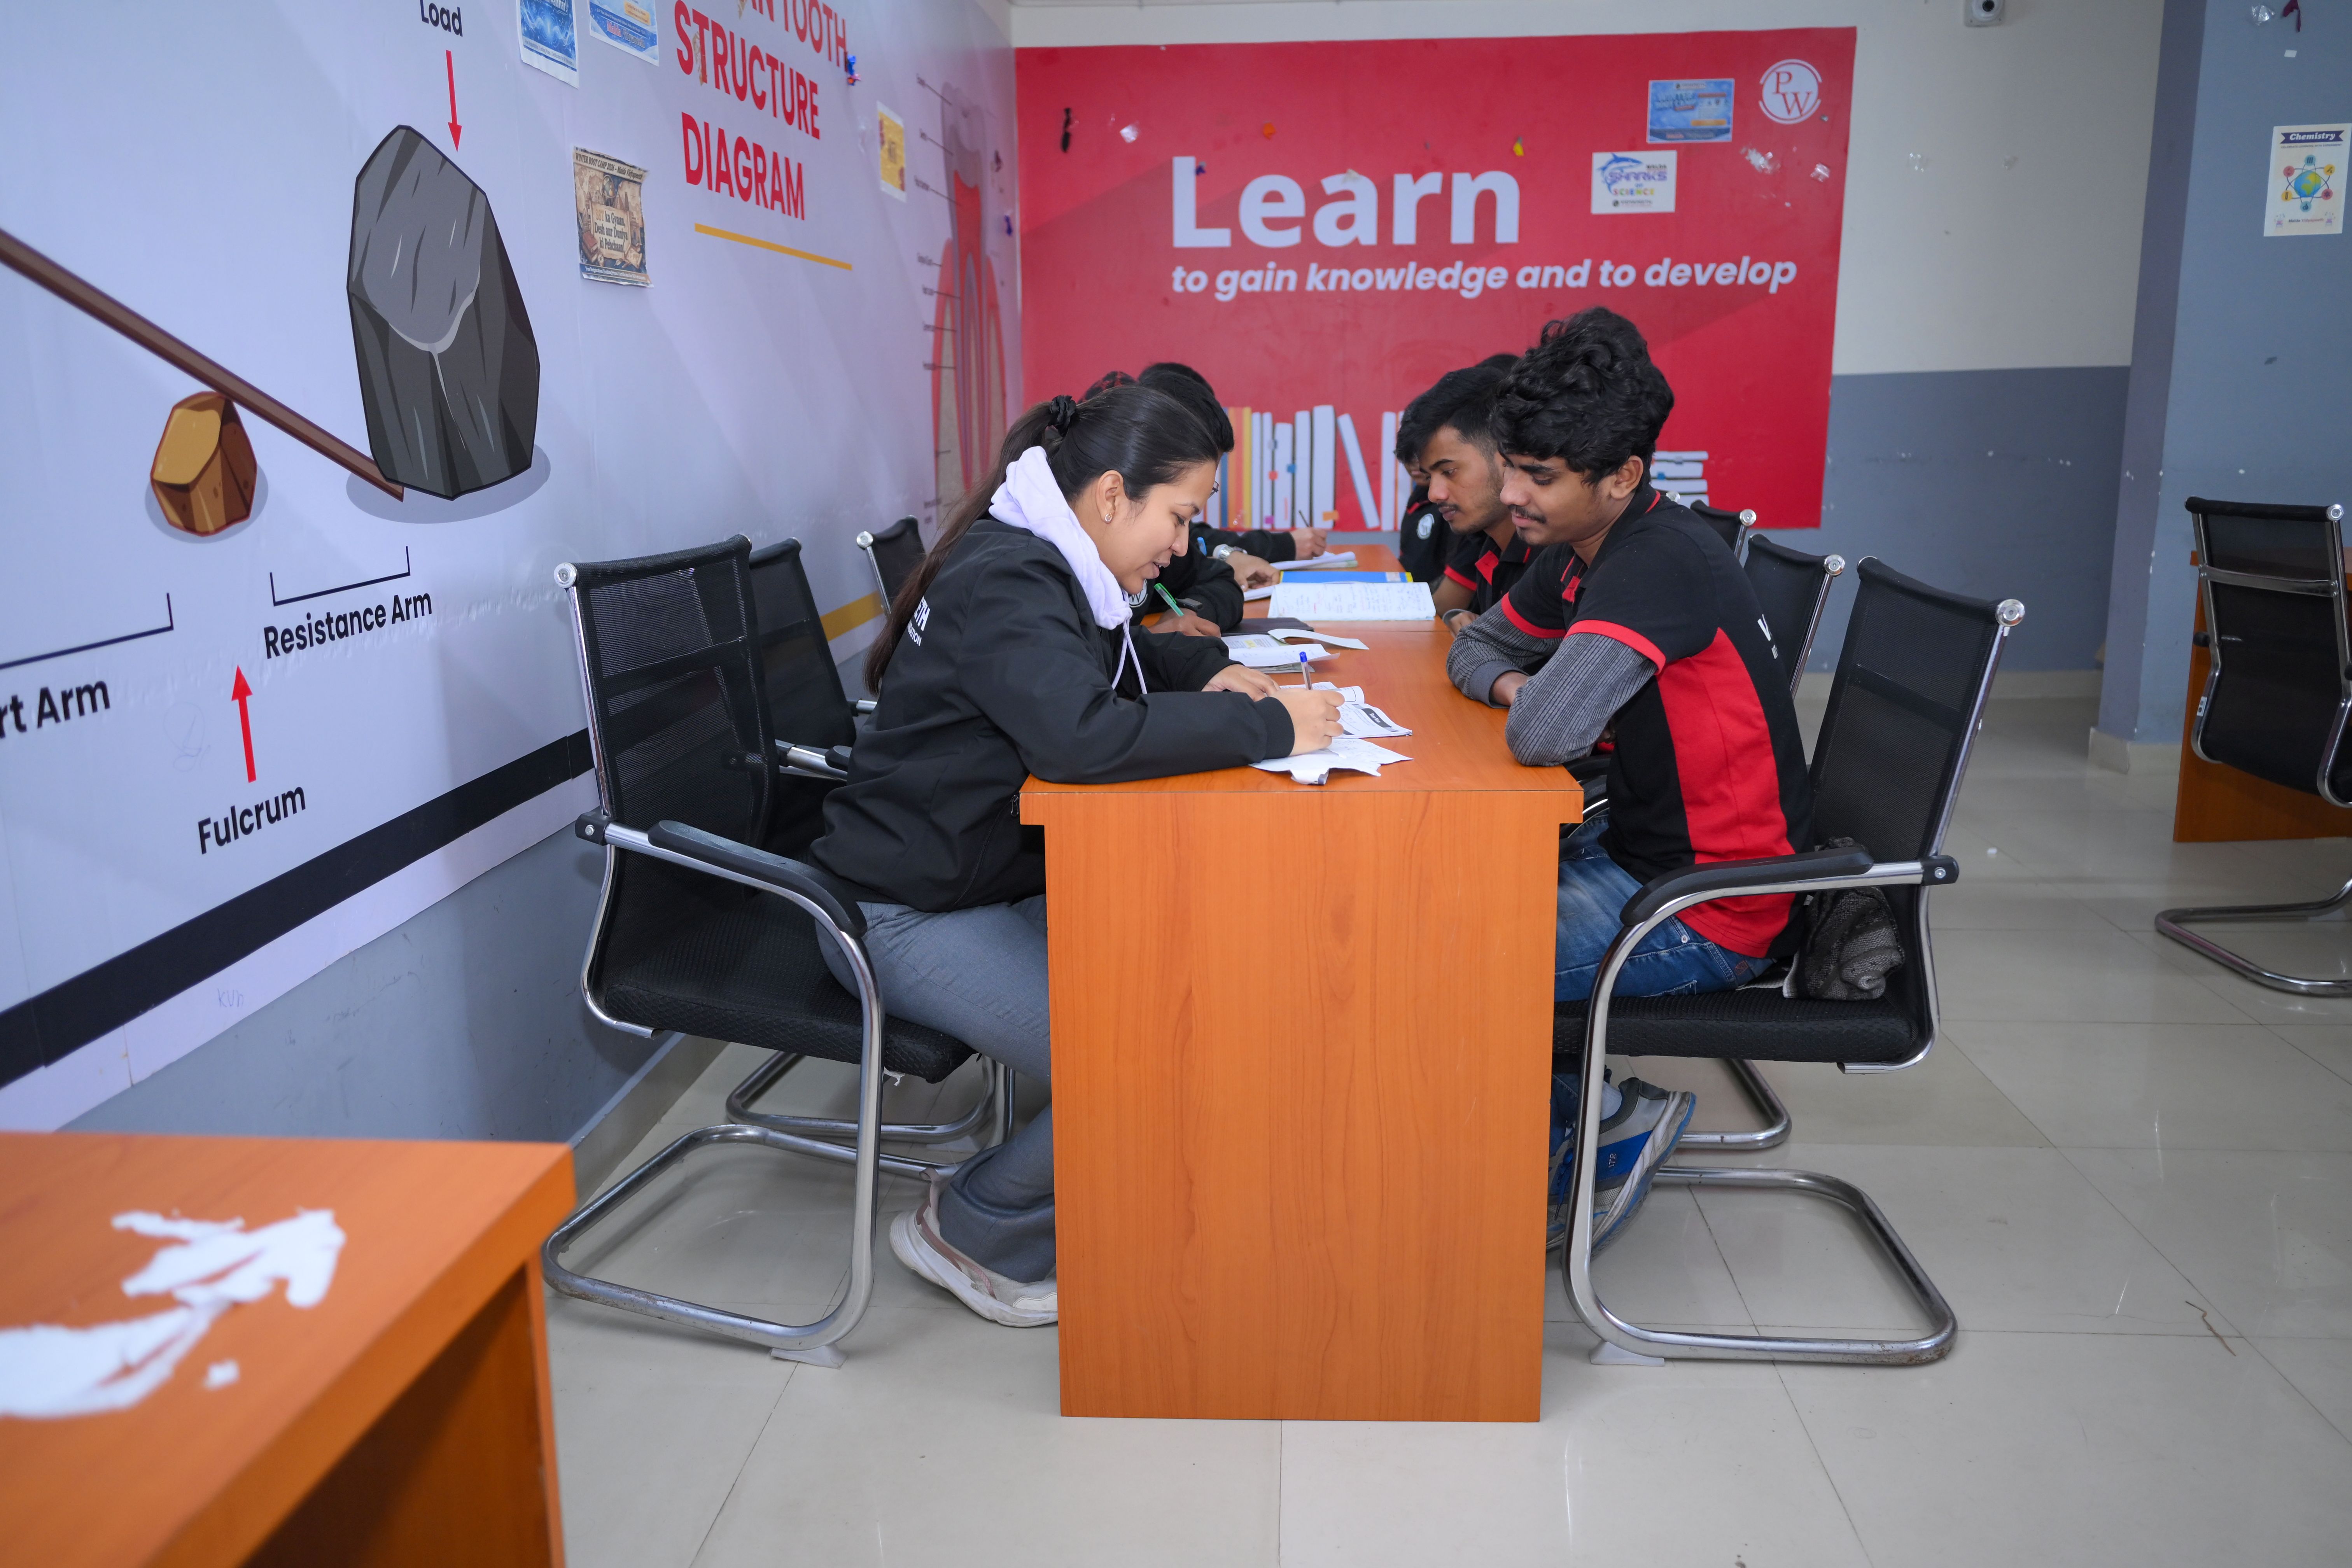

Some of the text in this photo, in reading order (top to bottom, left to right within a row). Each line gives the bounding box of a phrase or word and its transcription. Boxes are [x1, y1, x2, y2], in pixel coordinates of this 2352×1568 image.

[420, 0, 463, 37] Load
[674, 0, 820, 139] STRUCTURE
[2289, 132, 2336, 141] Chemistry
[576, 152, 588, 163] WINTER
[588, 156, 598, 167] BOOT
[597, 159, 607, 169] CAMP
[681, 112, 805, 220] DIAGRAM
[1172, 156, 1520, 248] Learn
[1613, 188, 1655, 196] SCIENCE
[594, 222, 605, 235] Desh
[614, 226, 628, 243] Duniya
[605, 210, 611, 223] ka
[599, 236, 604, 249] ki
[1171, 256, 1797, 302] to gain knowledge and to develop
[264, 593, 432, 659] Resistance Arm
[37, 680, 110, 728] Arm
[198, 787, 306, 854] Fulcrum
